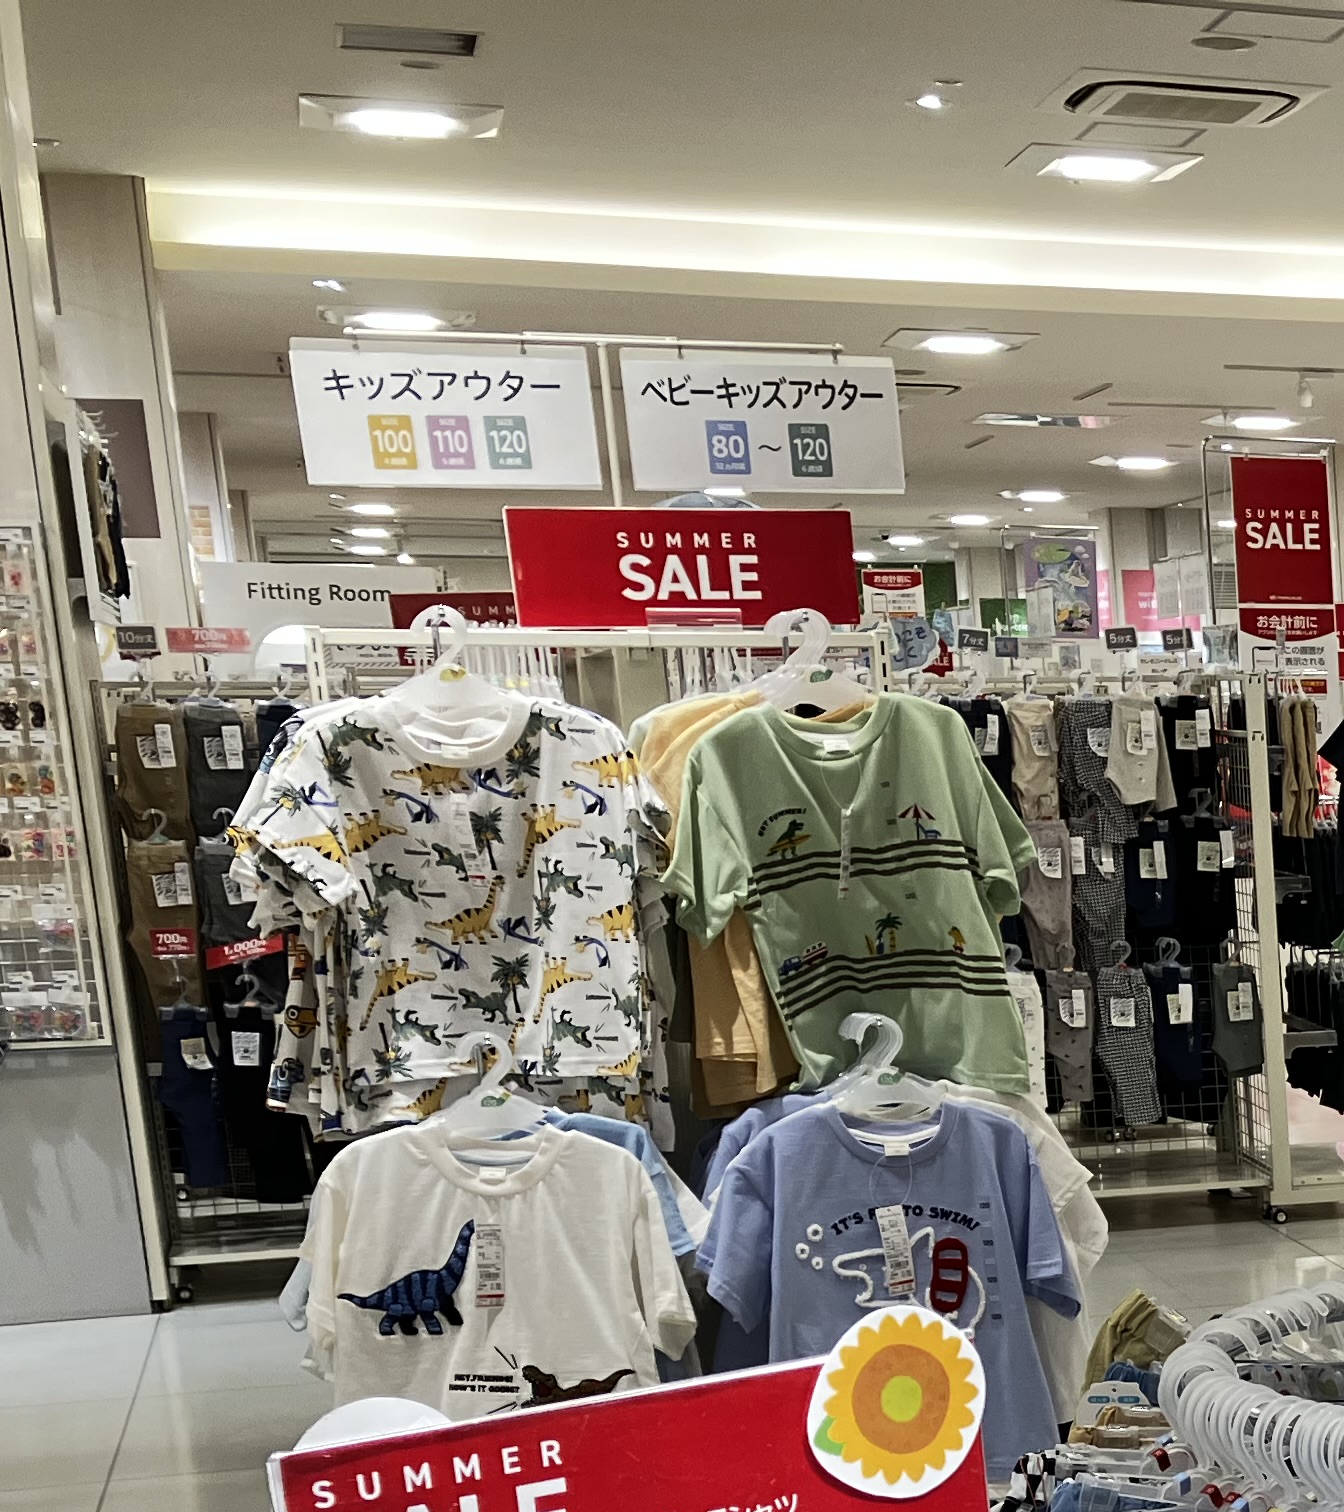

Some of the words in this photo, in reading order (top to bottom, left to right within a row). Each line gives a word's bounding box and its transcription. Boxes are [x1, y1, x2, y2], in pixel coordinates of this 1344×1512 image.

[323, 368, 560, 401] キッズアウター
[641, 374, 883, 411] ベビーキッズアウター
[373, 429, 412, 453] 100
[433, 429, 469, 453] 110
[489, 429, 527, 454] 120
[711, 434, 746, 459] 80
[793, 437, 828, 461] 120
[1245, 508, 1319, 520] SUMMER
[616, 532, 758, 549] SUMMER
[1245, 522, 1321, 551] SALE
[618, 554, 762, 601] SALE
[247, 582, 321, 606] Fitting
[329, 583, 392, 602] Room
[458, 606, 516, 616] SUMM
[1256, 615, 1318, 629] お会計前に
[962, 633, 985, 645] 7分丈
[1109, 633, 1133, 644] 5分丈
[830, 1210, 864, 1236] IT'S
[903, 1204, 924, 1217] TO
[929, 1206, 981, 1231] SWIM!
[311, 1440, 563, 1509] SUMMER
